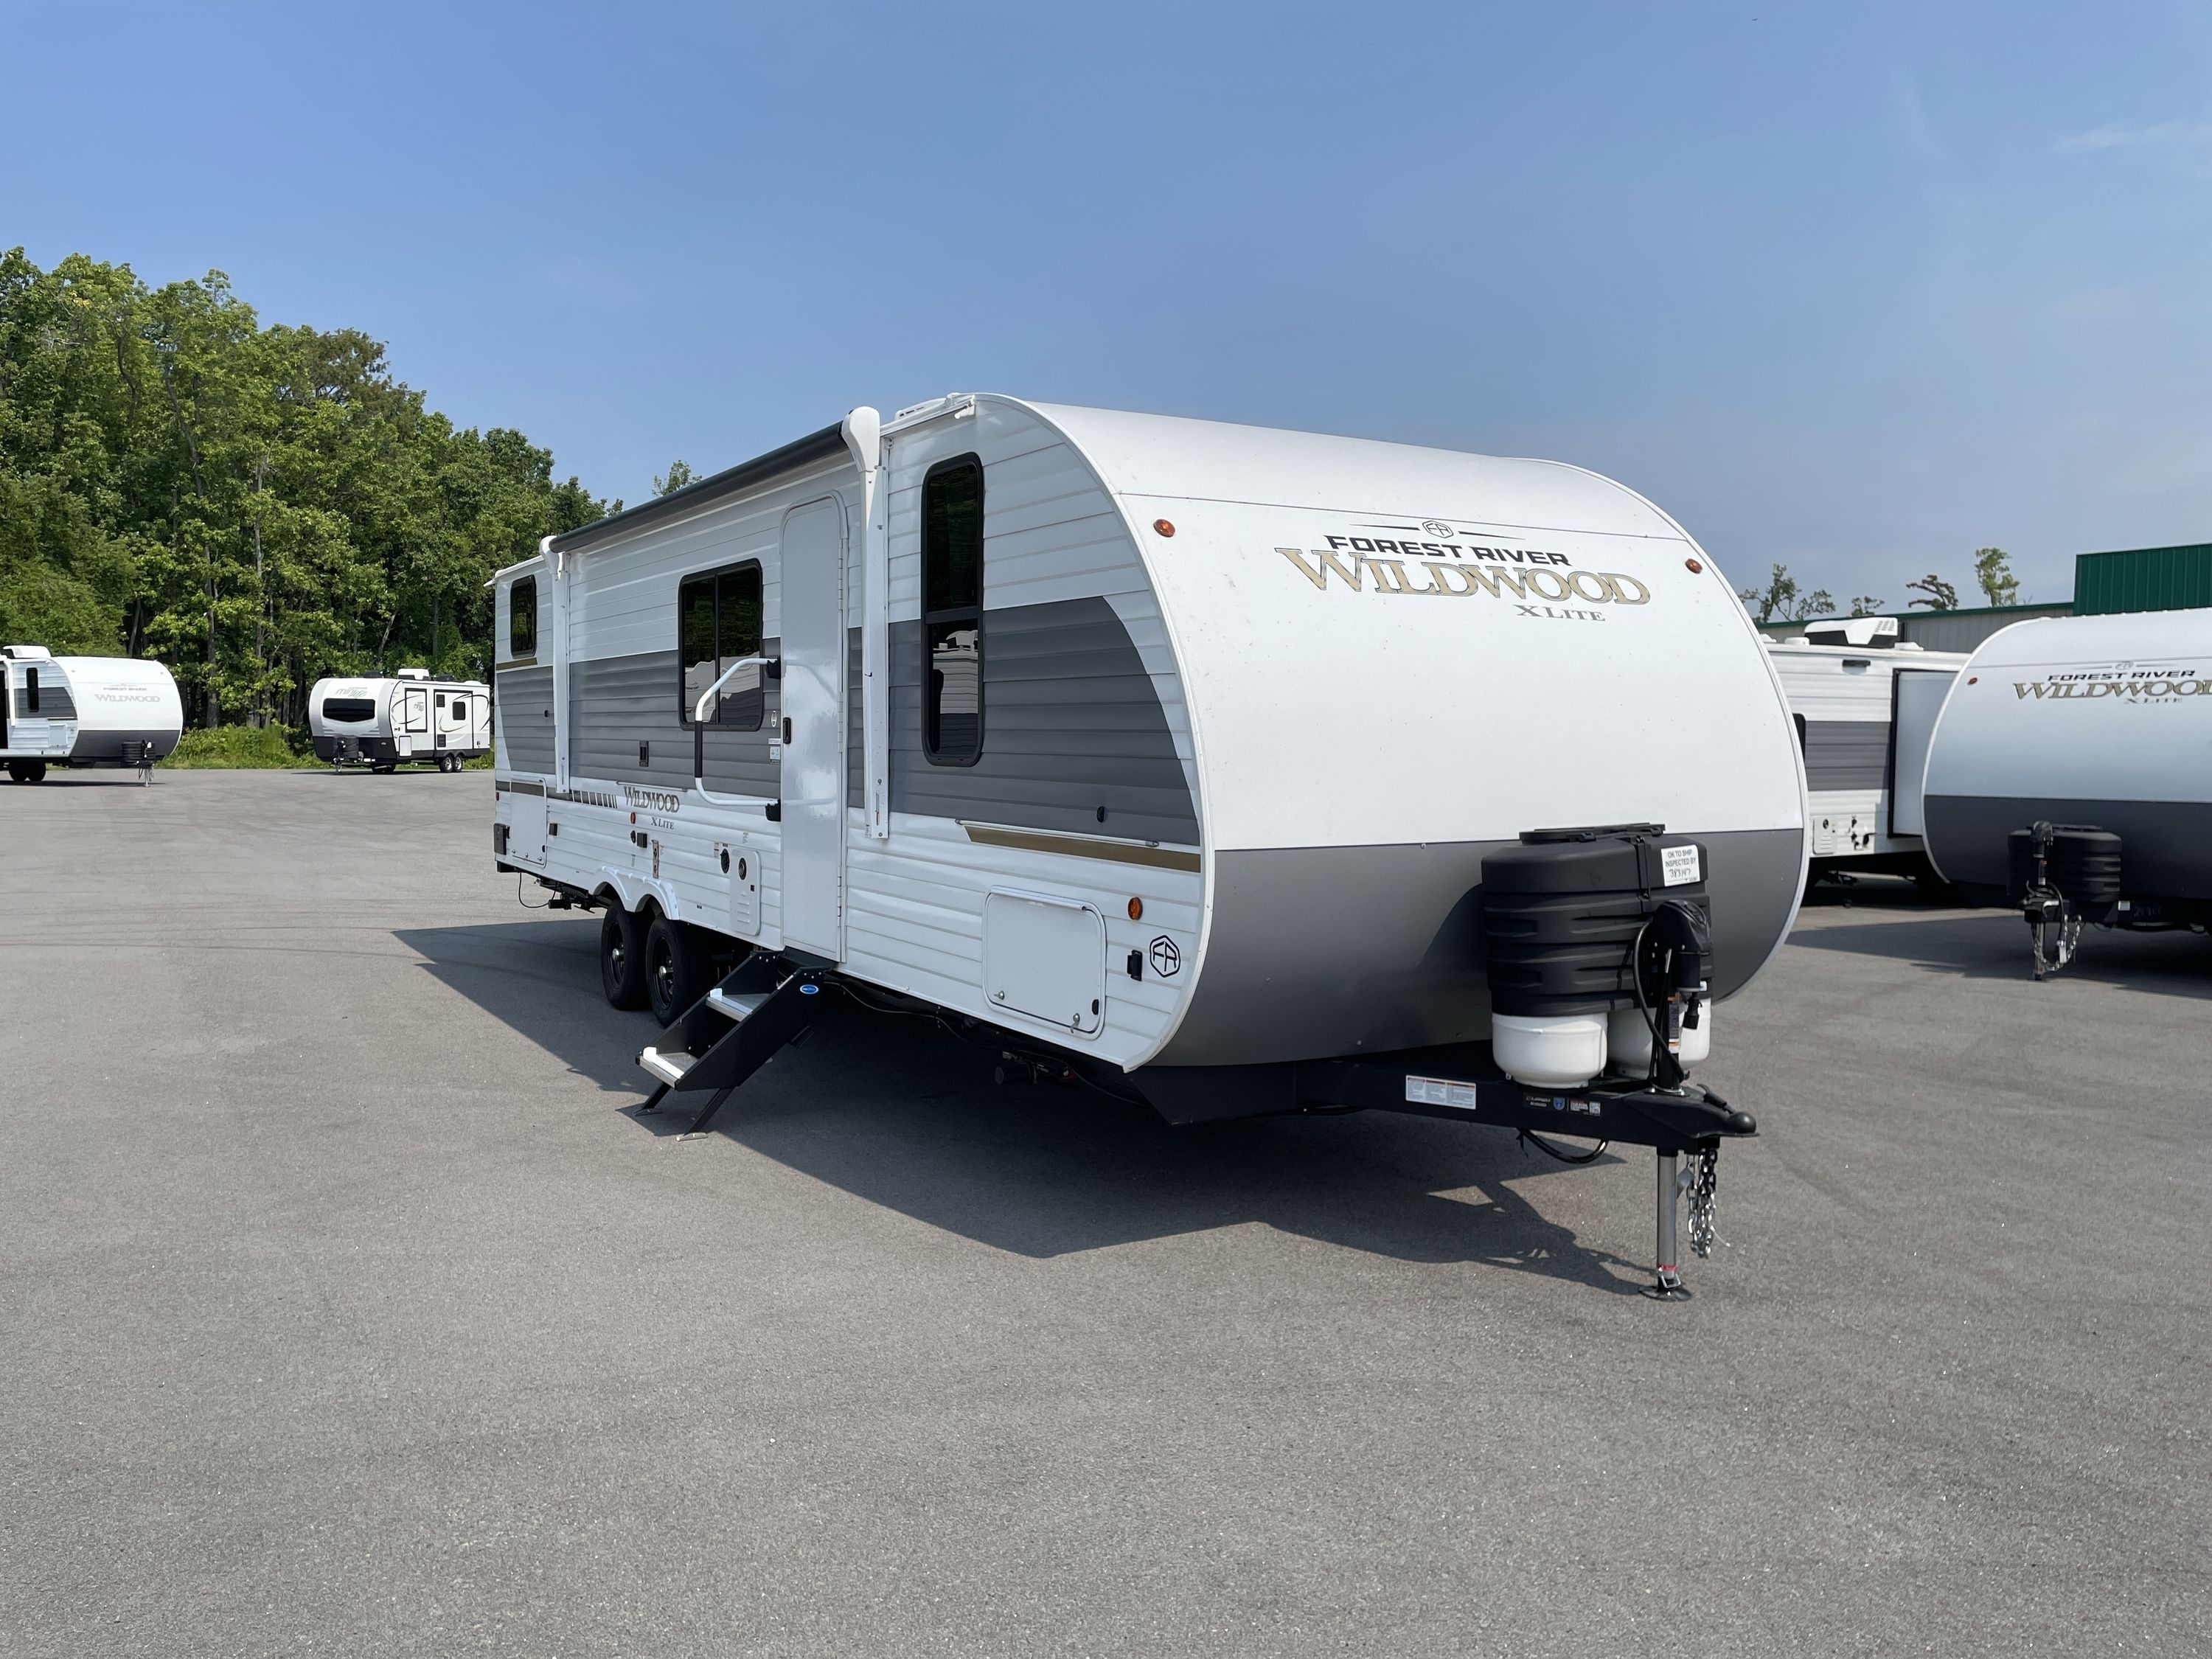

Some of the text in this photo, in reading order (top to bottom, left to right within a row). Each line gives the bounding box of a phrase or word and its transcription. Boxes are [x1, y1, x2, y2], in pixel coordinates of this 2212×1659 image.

[1324, 535, 1572, 566] FOREST RIVER
[1274, 548, 1650, 605] WILDWOOD
[2048, 669, 2195, 681] FOREST RIVER
[94, 694, 161, 702] WILDWOOD
[624, 786, 680, 813] WILDWOOD
[1665, 858, 1690, 867] INSPECTED
